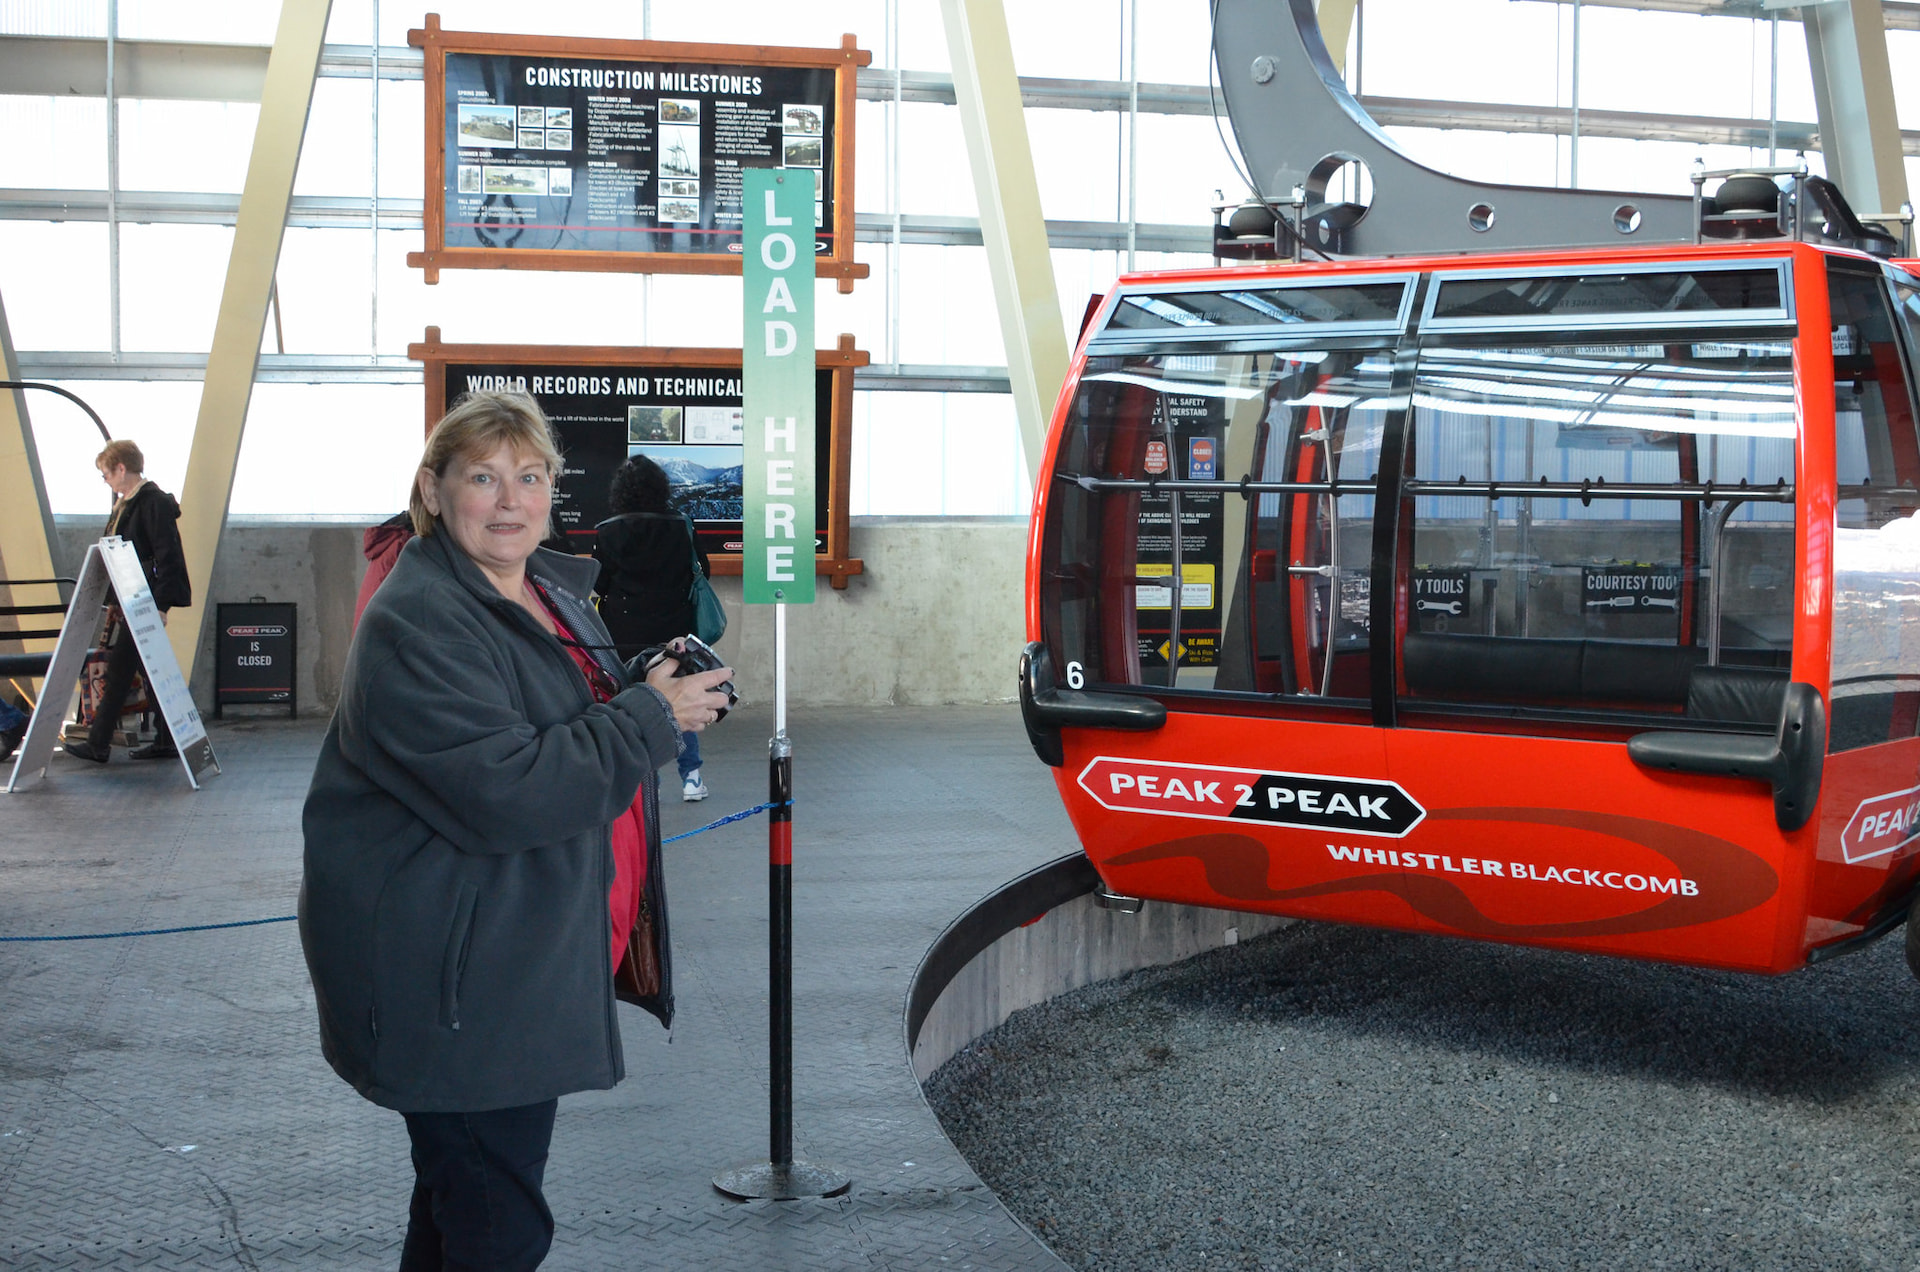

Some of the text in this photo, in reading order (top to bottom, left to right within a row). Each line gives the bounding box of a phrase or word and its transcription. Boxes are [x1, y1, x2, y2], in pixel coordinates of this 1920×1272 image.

[526, 67, 762, 95] CONSTRUCTION MILESTONES
[466, 375, 744, 397] WORLD RECORDS AND TECHNICAL
[760, 190, 797, 582] LOAD HERE
[1427, 579, 1464, 594] TOOLS
[1587, 575, 1648, 590] COURTESY
[238, 656, 272, 666] CLOSED
[250, 642, 260, 652] IS
[1066, 661, 1084, 690] 6
[1109, 772, 1392, 821] PEAK 2 PEAK
[1858, 802, 1916, 842] PEAK
[1326, 843, 1700, 897] WHISTLER BLACKCOMB
